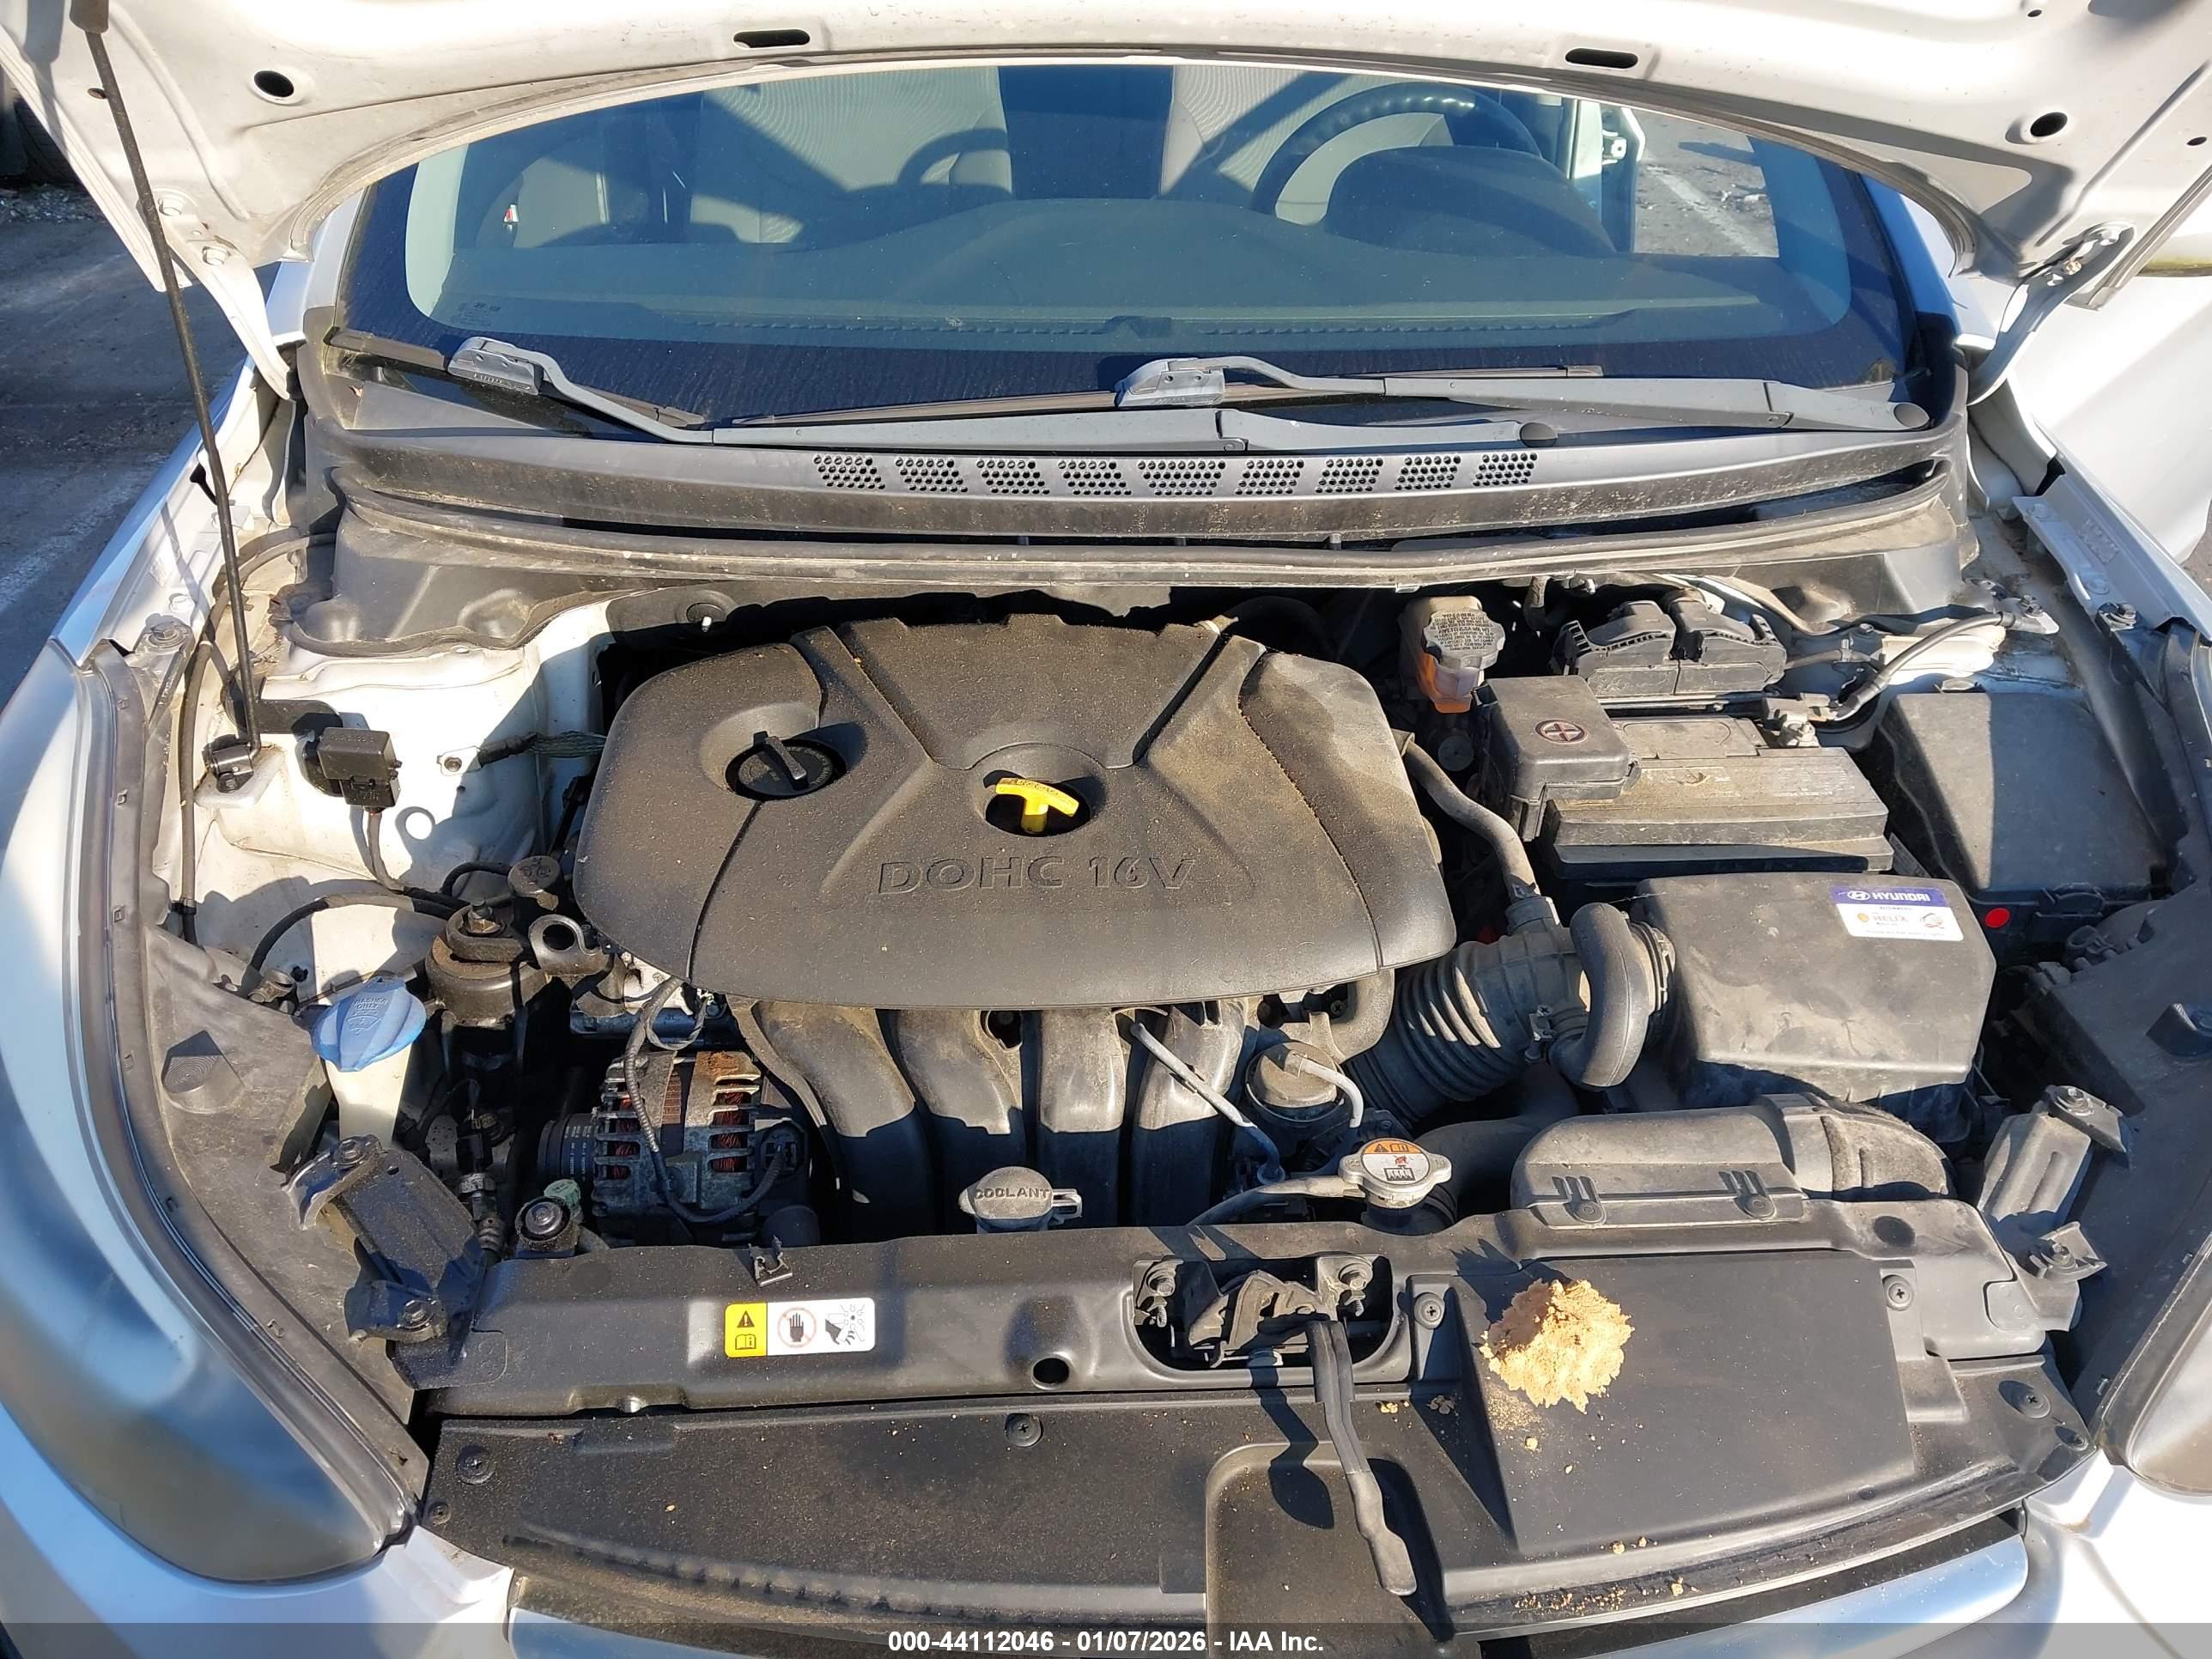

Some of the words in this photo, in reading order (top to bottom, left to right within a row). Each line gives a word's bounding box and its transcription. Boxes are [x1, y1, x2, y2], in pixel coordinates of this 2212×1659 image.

[878, 855, 1065, 896] DOHC
[1088, 854, 1196, 890] 16V
[1872, 892, 1931, 902] HYUNDAI
[975, 1187, 1050, 1200] COOLANT
